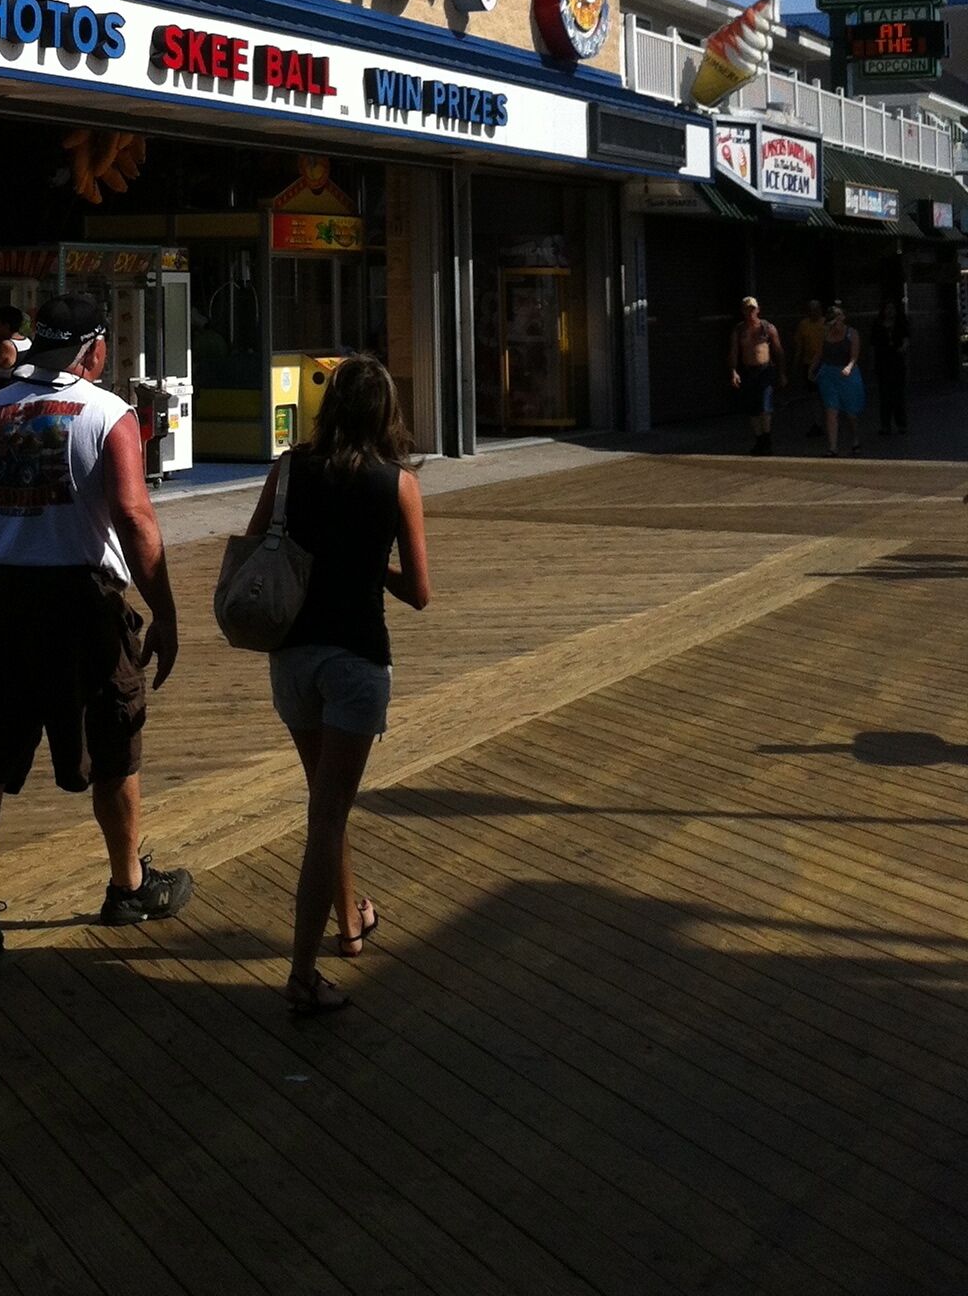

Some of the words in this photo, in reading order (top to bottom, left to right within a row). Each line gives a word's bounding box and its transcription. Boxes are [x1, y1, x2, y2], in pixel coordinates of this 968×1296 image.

[869, 7, 922, 21] TAFFY
[879, 23, 907, 38] AT
[874, 37, 913, 54] THE
[162, 24, 249, 82] SKEE
[265, 46, 338, 97] BALL
[867, 58, 928, 73] POPCORN
[375, 67, 423, 112] WIN
[433, 80, 509, 127] PRIZES
[765, 169, 781, 190] ICE
[781, 172, 810, 195] CREAM
